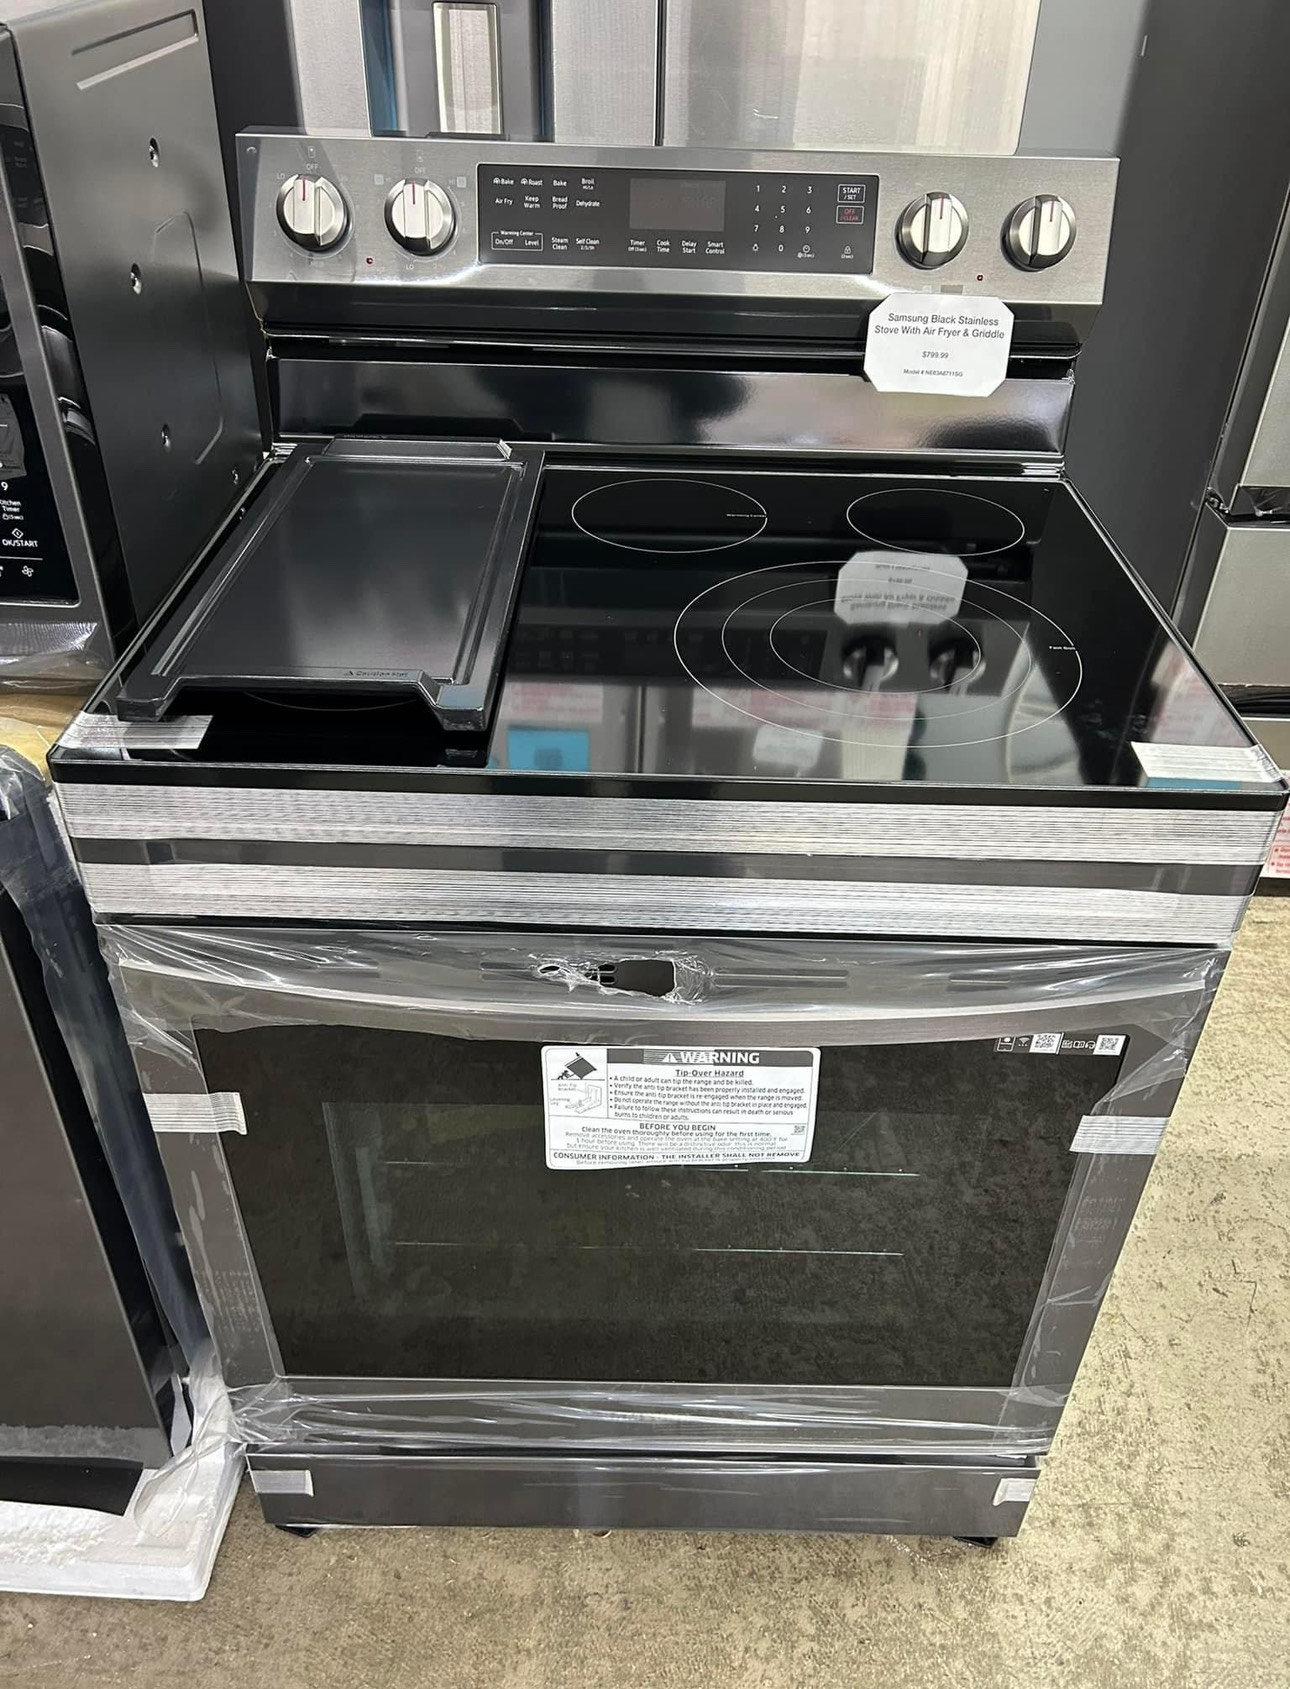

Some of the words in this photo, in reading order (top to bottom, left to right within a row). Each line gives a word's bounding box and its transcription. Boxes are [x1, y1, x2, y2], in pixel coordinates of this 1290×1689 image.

[529, 178, 543, 186] Roast
[553, 179, 567, 187] Bake
[581, 177, 595, 185] Broil
[781, 185, 787, 193] 2
[807, 186, 813, 194] 3
[504, 197, 513, 206] Fry
[552, 195, 568, 203] Bread
[576, 200, 600, 208] Dehydrate
[806, 206, 812, 214] 6
[779, 225, 785, 233] 8
[805, 226, 811, 234] 9
[681, 240, 697, 248] Delay
[778, 244, 784, 252] 0
[888, 312, 929, 325] Samsung
[931, 314, 957, 325] Black
[958, 315, 999, 327] Stainless
[874, 325, 899, 334] Stove
[901, 326, 921, 335] With
[923, 327, 936, 336] Air
[938, 327, 961, 339] Fryer
[963, 329, 970, 338] &
[971, 328, 1005, 339] Griddle
[922, 350, 949, 359] $799.99
[1, 481, 8, 491] 9
[2, 538, 38, 548] OK/START
[680, 1051, 760, 1064] WARNING
[675, 1069, 712, 1078] Tip-Over
[715, 1070, 744, 1078] Hazard
[639, 1123, 670, 1131] BEFORE
[672, 1123, 690, 1131] YOU
[632, 1129, 670, 1137] thoroughly
[695, 1130, 714, 1138] using
[553, 1152, 597, 1160] CONSUMER
